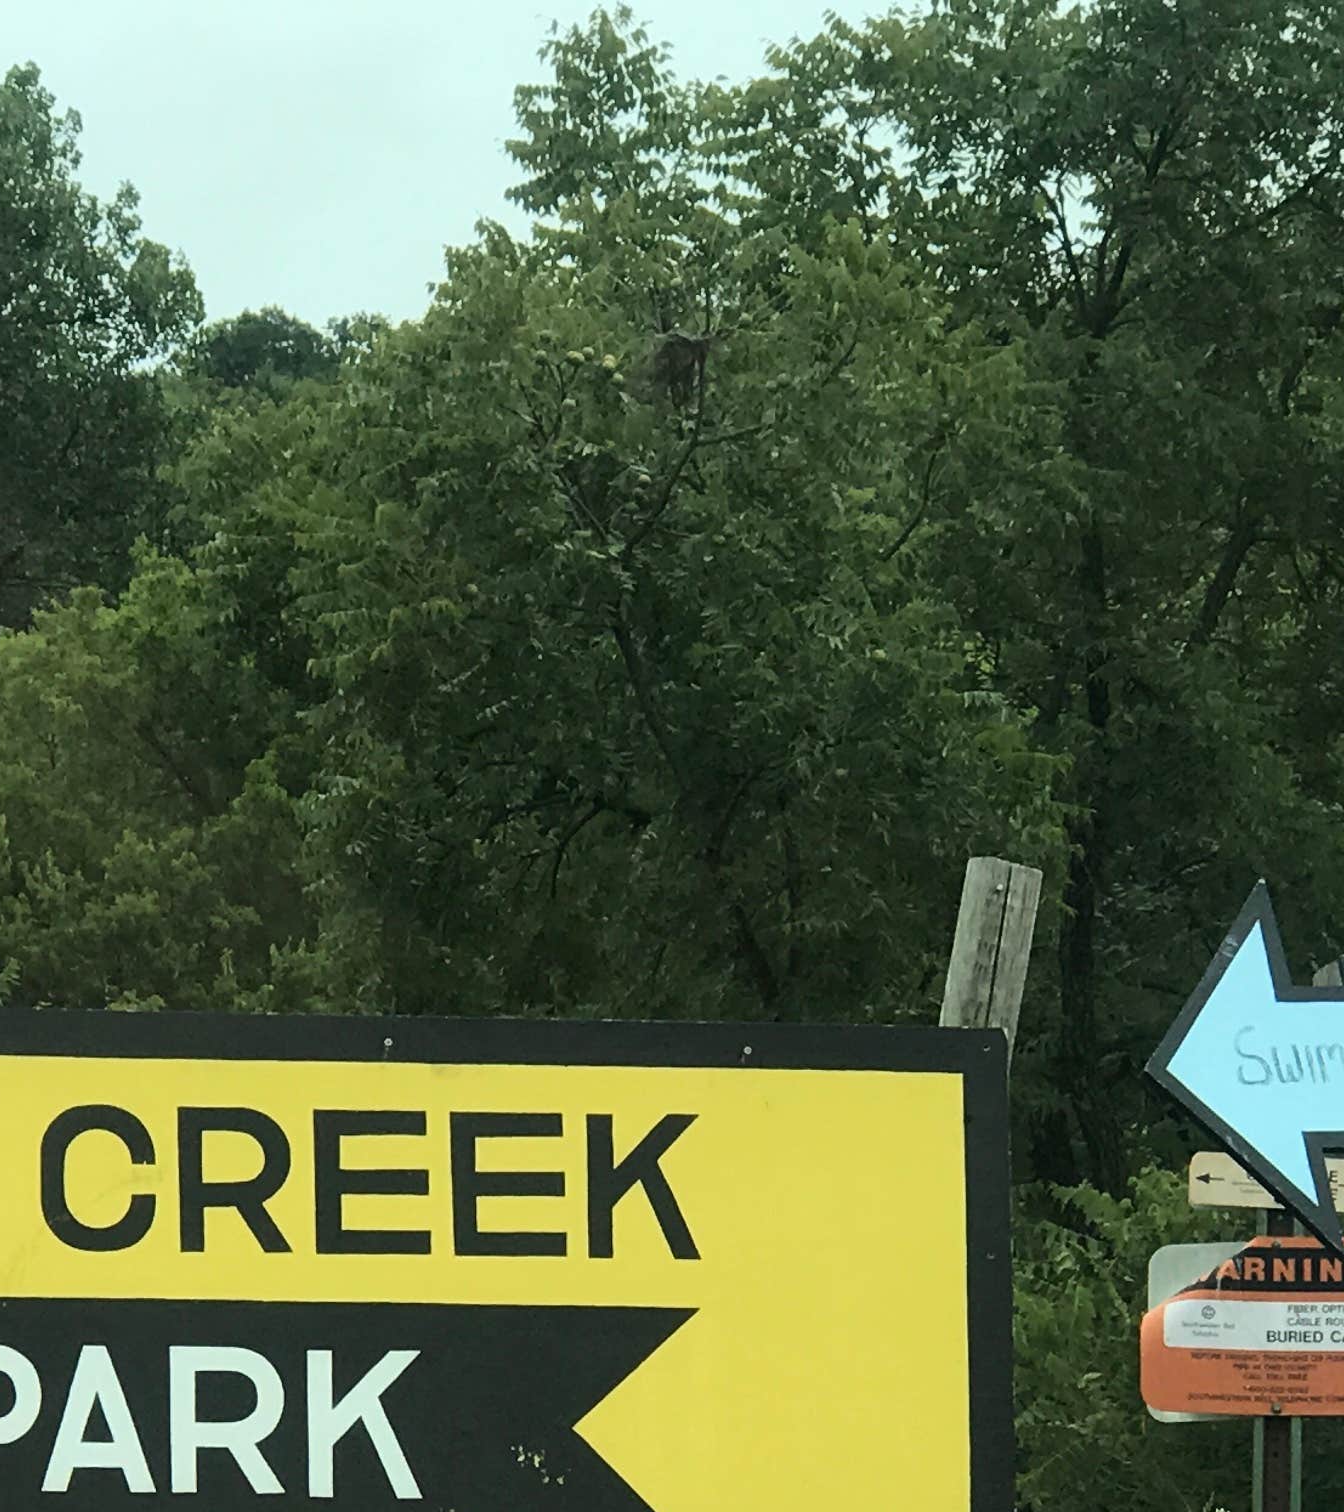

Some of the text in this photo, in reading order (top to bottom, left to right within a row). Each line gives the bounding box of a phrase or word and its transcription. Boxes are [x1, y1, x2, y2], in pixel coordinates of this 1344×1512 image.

[39, 1103, 701, 1261] CREEK
[1287, 1317, 1321, 1327] CABLE
[1266, 1330, 1324, 1344] BURIED
